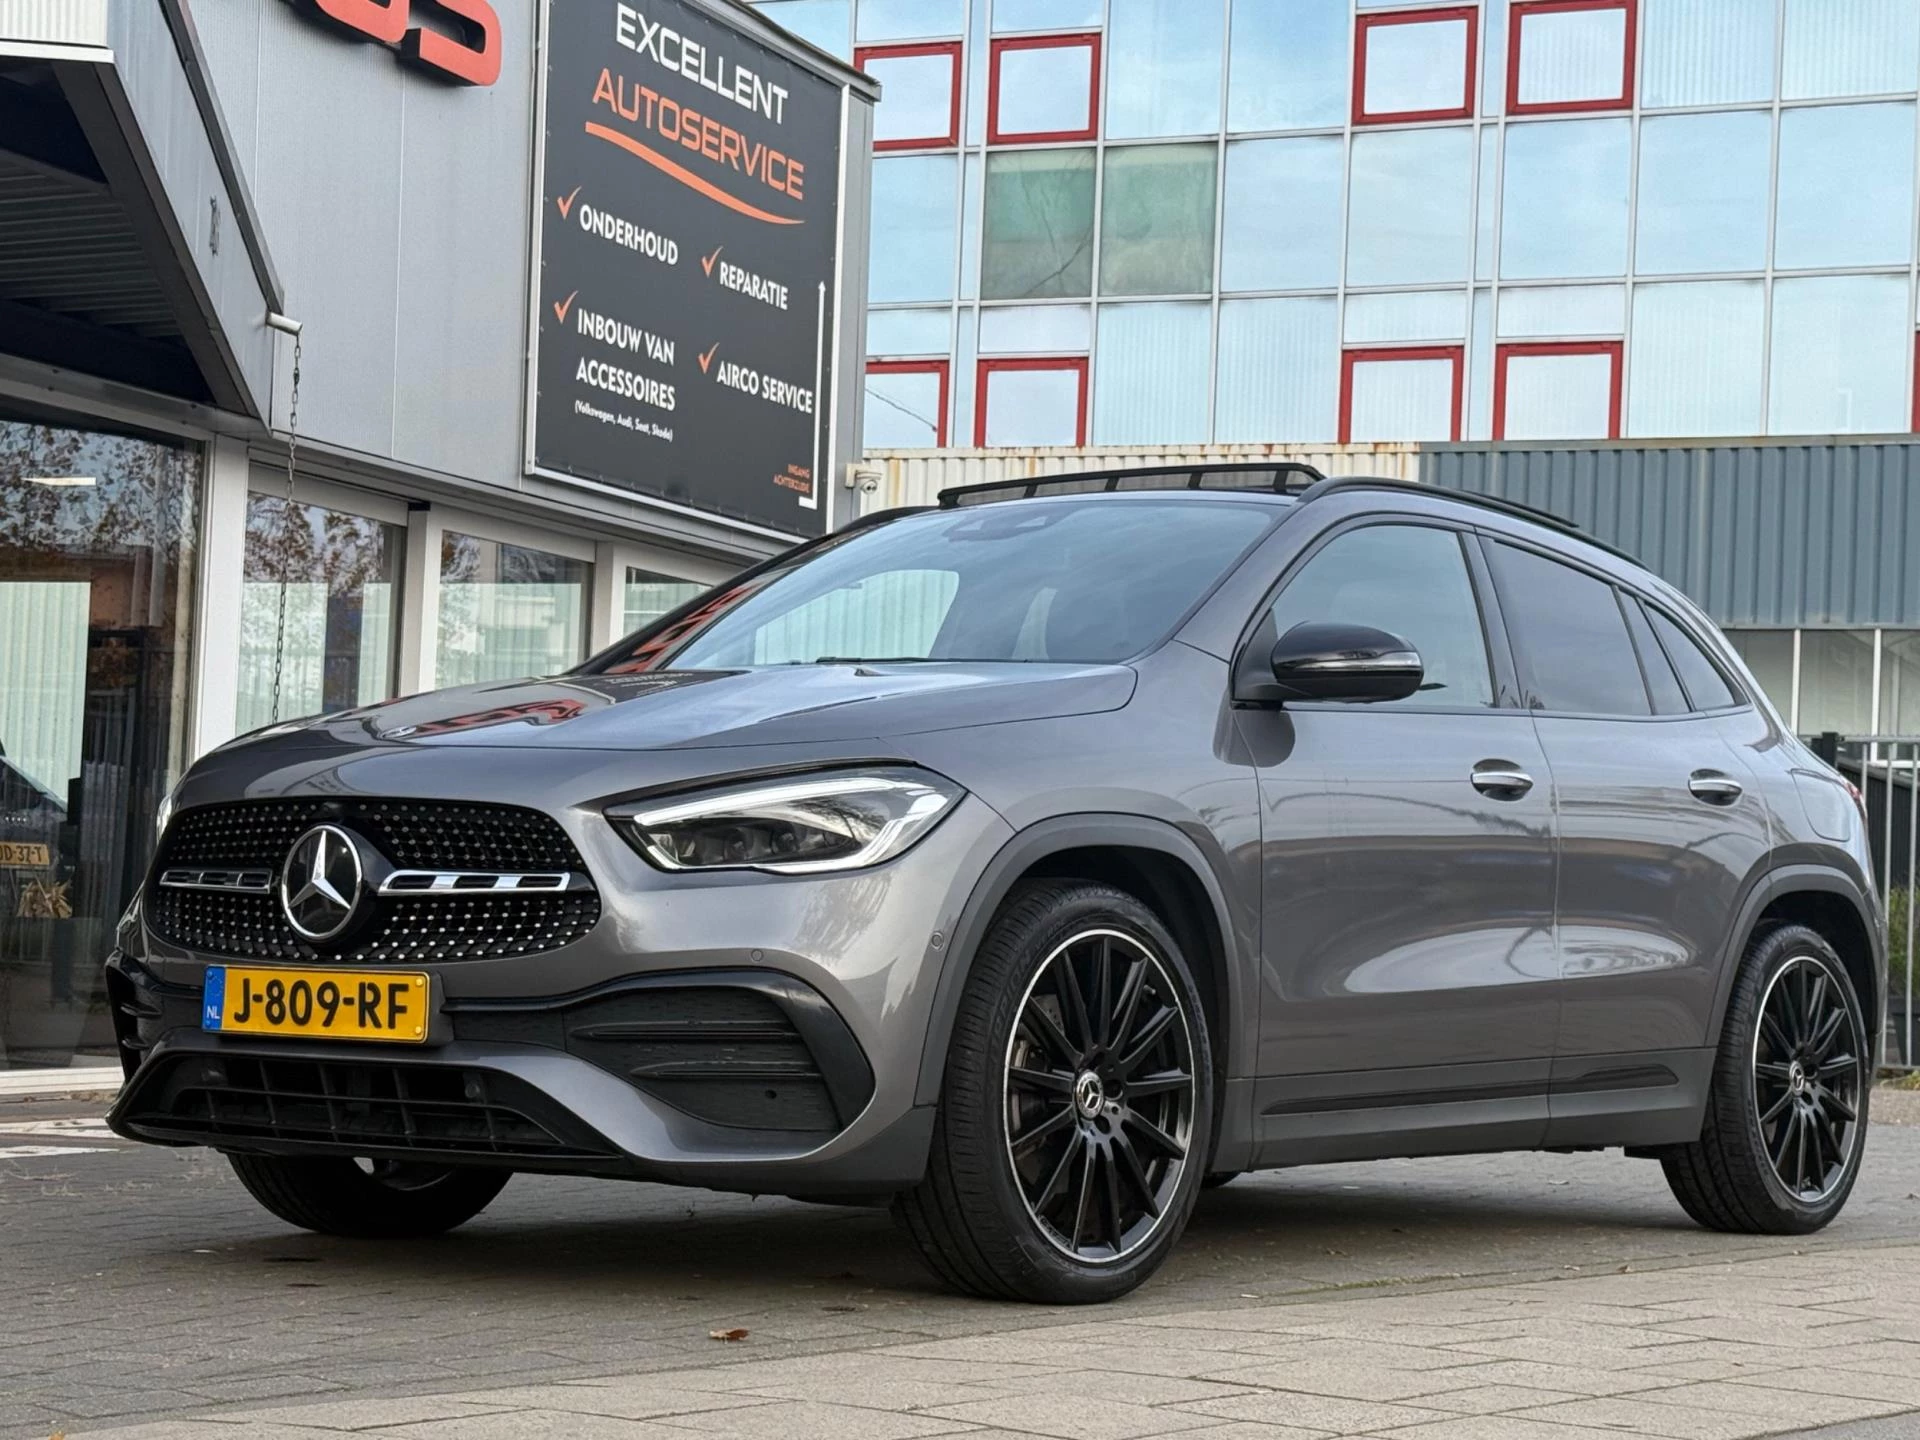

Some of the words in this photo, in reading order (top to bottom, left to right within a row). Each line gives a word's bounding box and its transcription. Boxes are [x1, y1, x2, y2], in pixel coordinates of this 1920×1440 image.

[616, 3, 788, 125] EXCELLENT
[592, 68, 805, 200] AUTOSERVICE
[579, 204, 679, 266] ONDERHOUD
[719, 261, 789, 311] REPARATIE
[577, 307, 643, 353] INBOUW
[645, 332, 675, 366] VAN
[576, 357, 676, 412] ACCESSOIRES
[716, 360, 760, 396] AIRCO
[762, 375, 813, 414] SERVICE
[206, 1005, 221, 1020] NL
[233, 977, 410, 1030] J-809-RF
